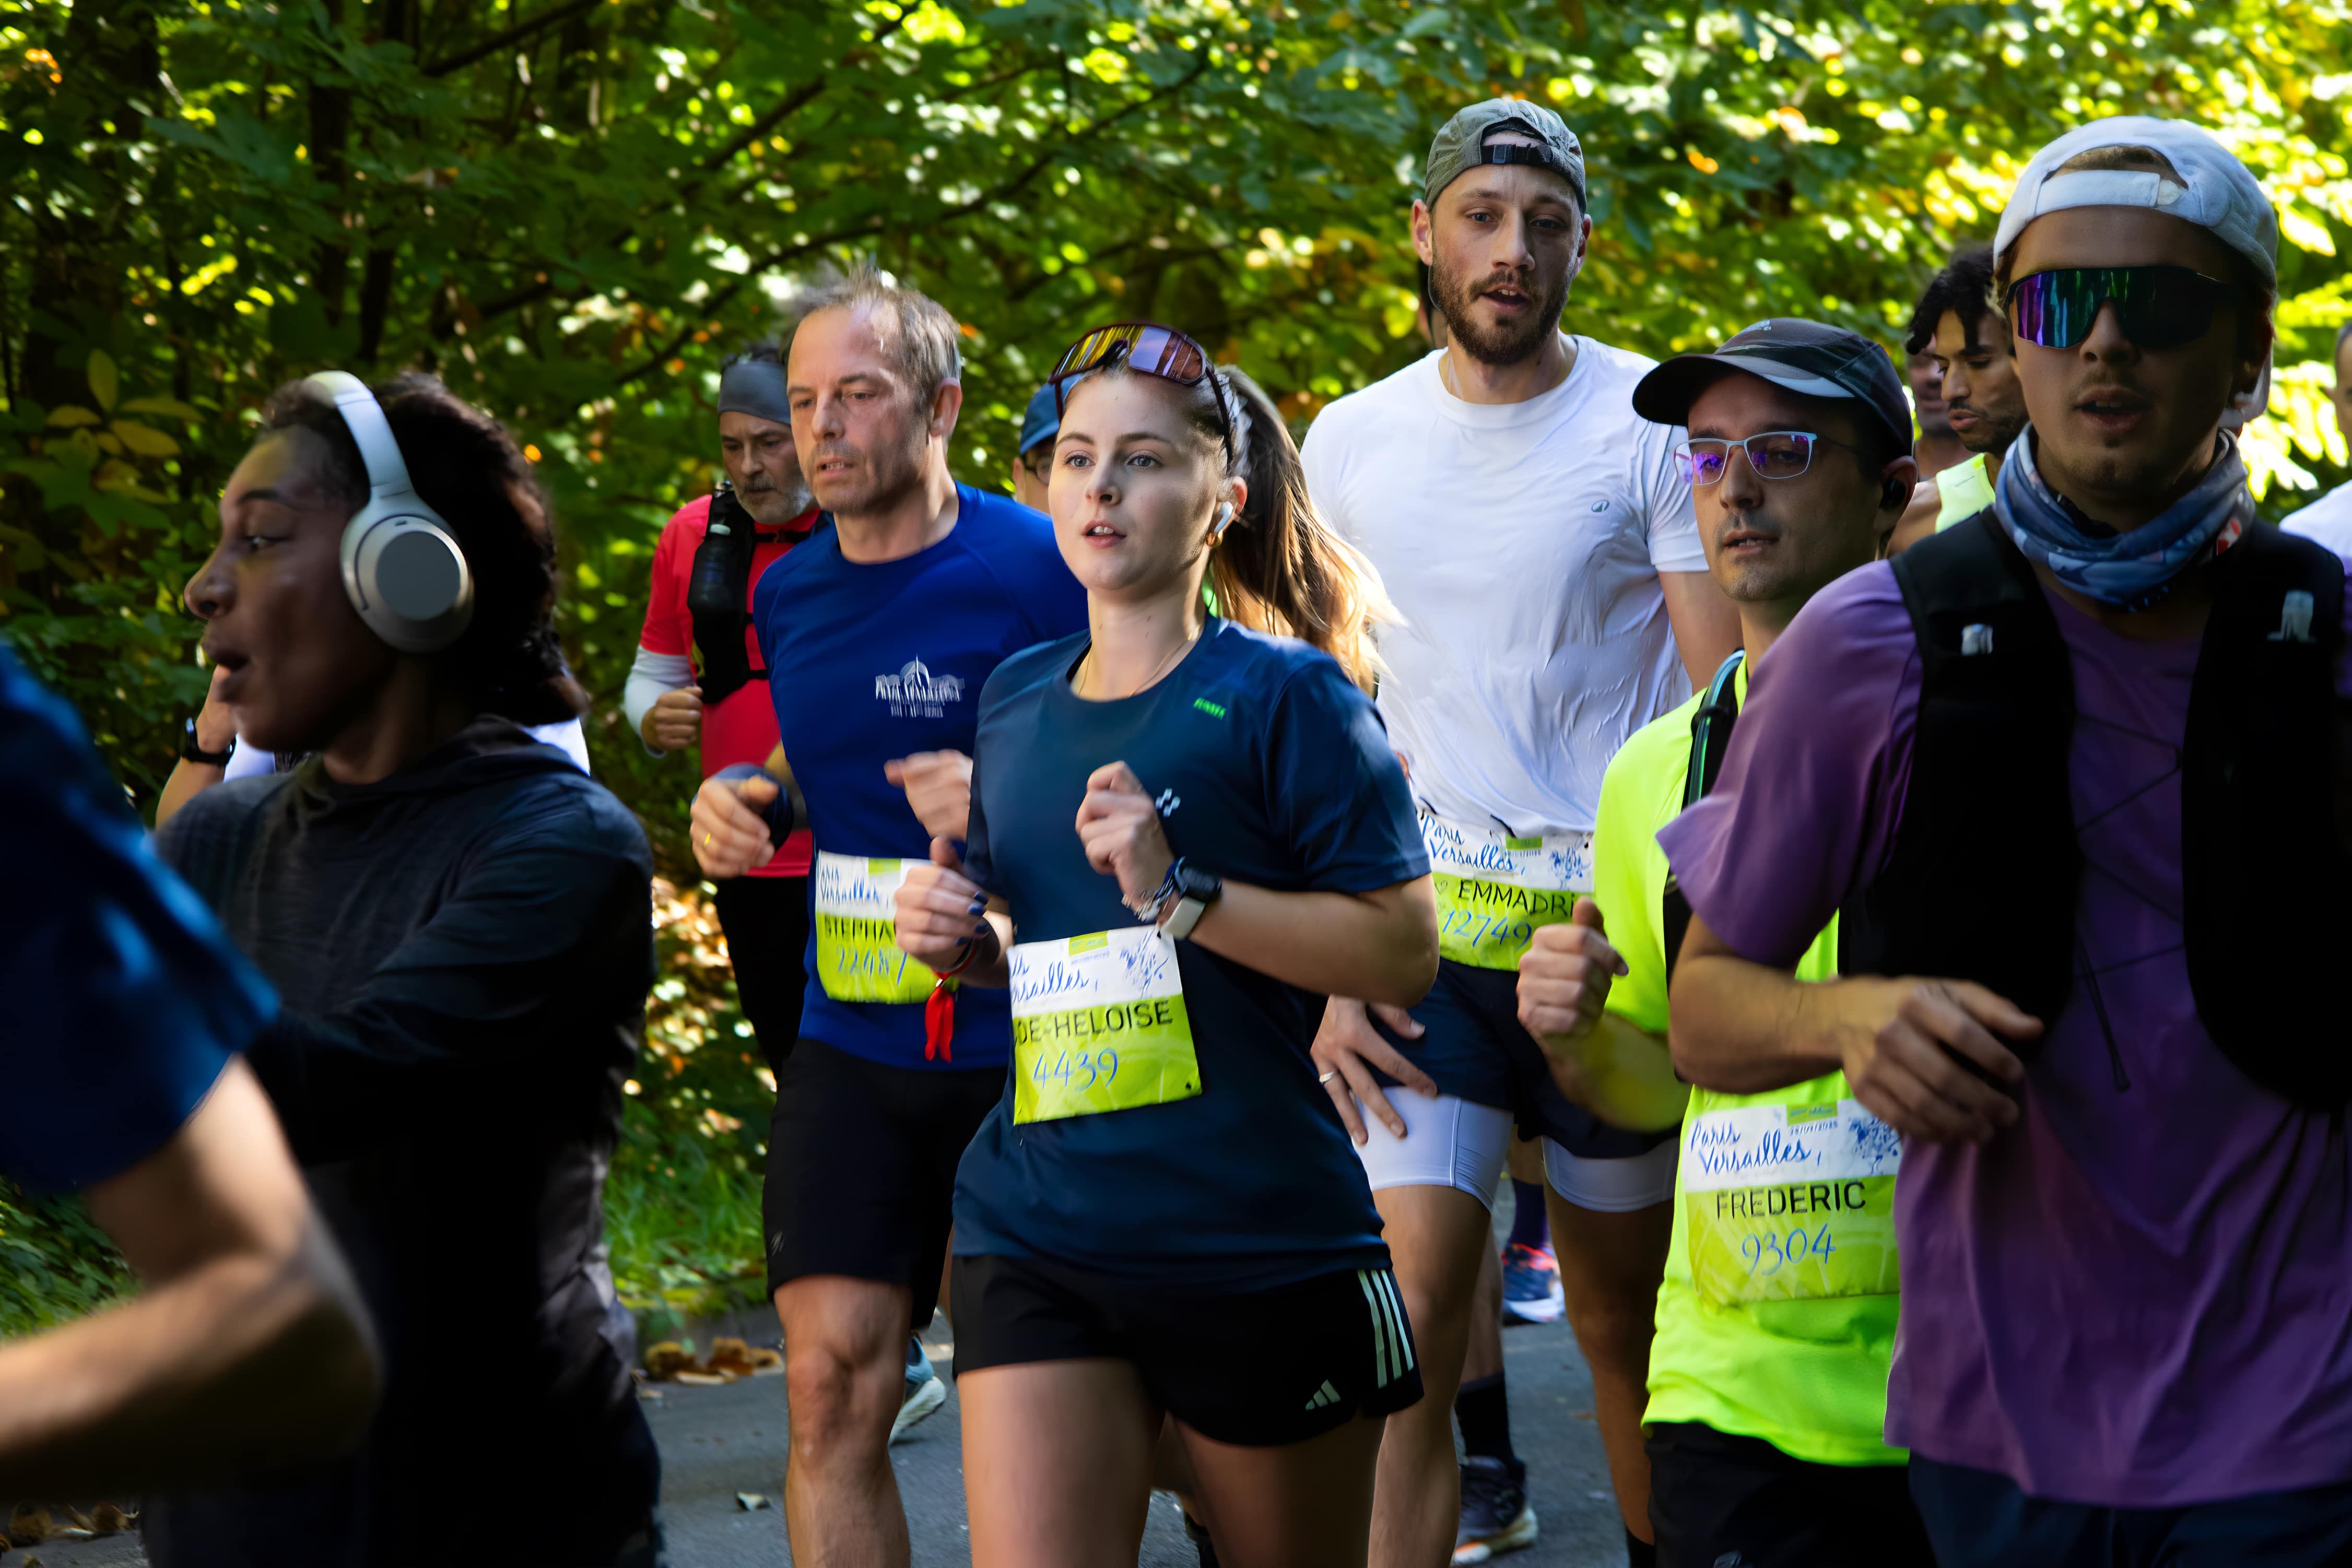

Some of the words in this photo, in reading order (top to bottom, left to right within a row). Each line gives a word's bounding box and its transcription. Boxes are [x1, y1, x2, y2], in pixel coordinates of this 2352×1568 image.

[1421, 815, 1465, 845] Paris
[825, 914, 897, 945] STEPHA
[1442, 909, 1532, 951] 12749
[1033, 1047, 1118, 1091] 4439
[1690, 1119, 1742, 1152] Paris
[1716, 1181, 1867, 1220] FREDERIC
[1742, 1222, 1837, 1277] 9304
